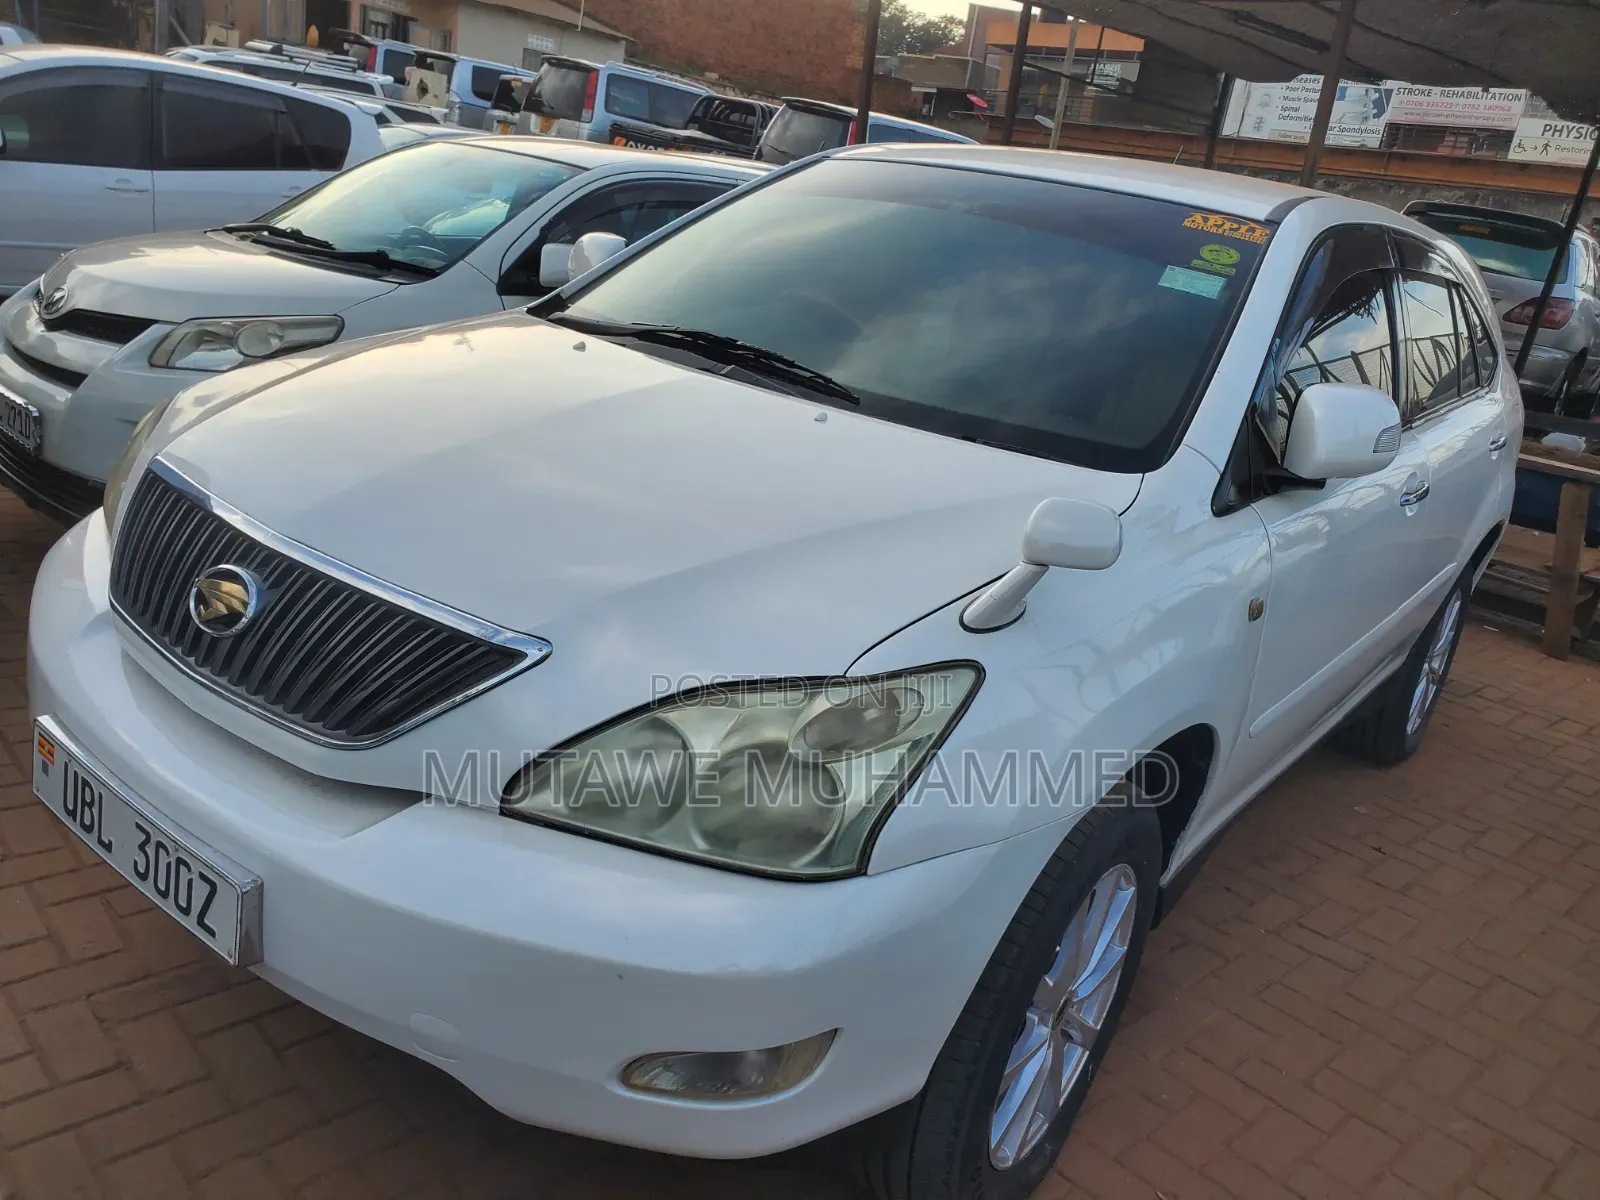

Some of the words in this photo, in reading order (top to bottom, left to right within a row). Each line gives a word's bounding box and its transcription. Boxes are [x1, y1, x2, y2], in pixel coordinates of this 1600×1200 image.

[1396, 88, 1433, 97] STROKE
[1440, 90, 1523, 102] REHABILITATION
[1280, 105, 1300, 113] Spinal
[1337, 125, 1381, 136] Spondylosis
[1182, 220, 1224, 235] MOTORS
[1184, 213, 1270, 238] APPLE
[63, 760, 112, 854] UBL
[133, 820, 218, 939] 300Z
